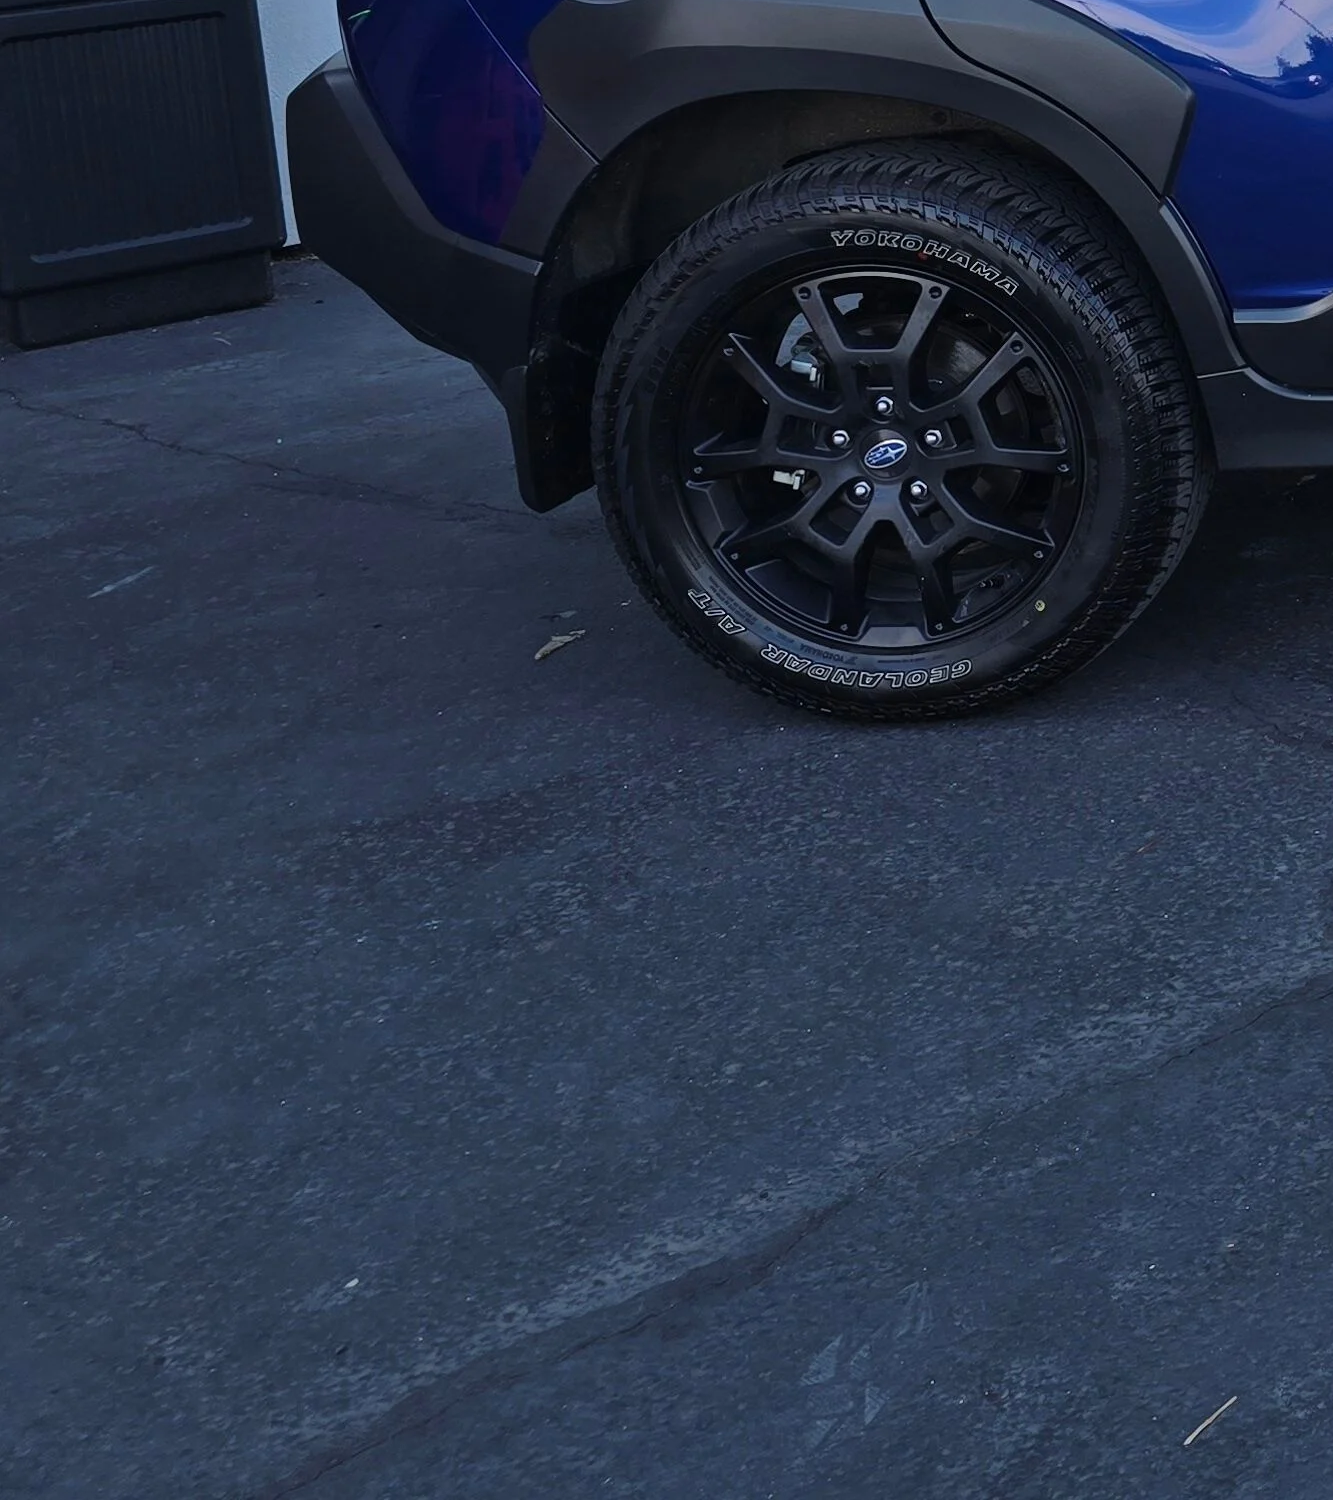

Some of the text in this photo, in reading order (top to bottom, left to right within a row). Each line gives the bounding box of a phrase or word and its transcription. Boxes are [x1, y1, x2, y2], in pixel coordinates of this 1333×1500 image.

[831, 229, 1020, 296] YOKOHAMA
[688, 588, 747, 635] A/T
[760, 643, 972, 688] GEOLANDAR
